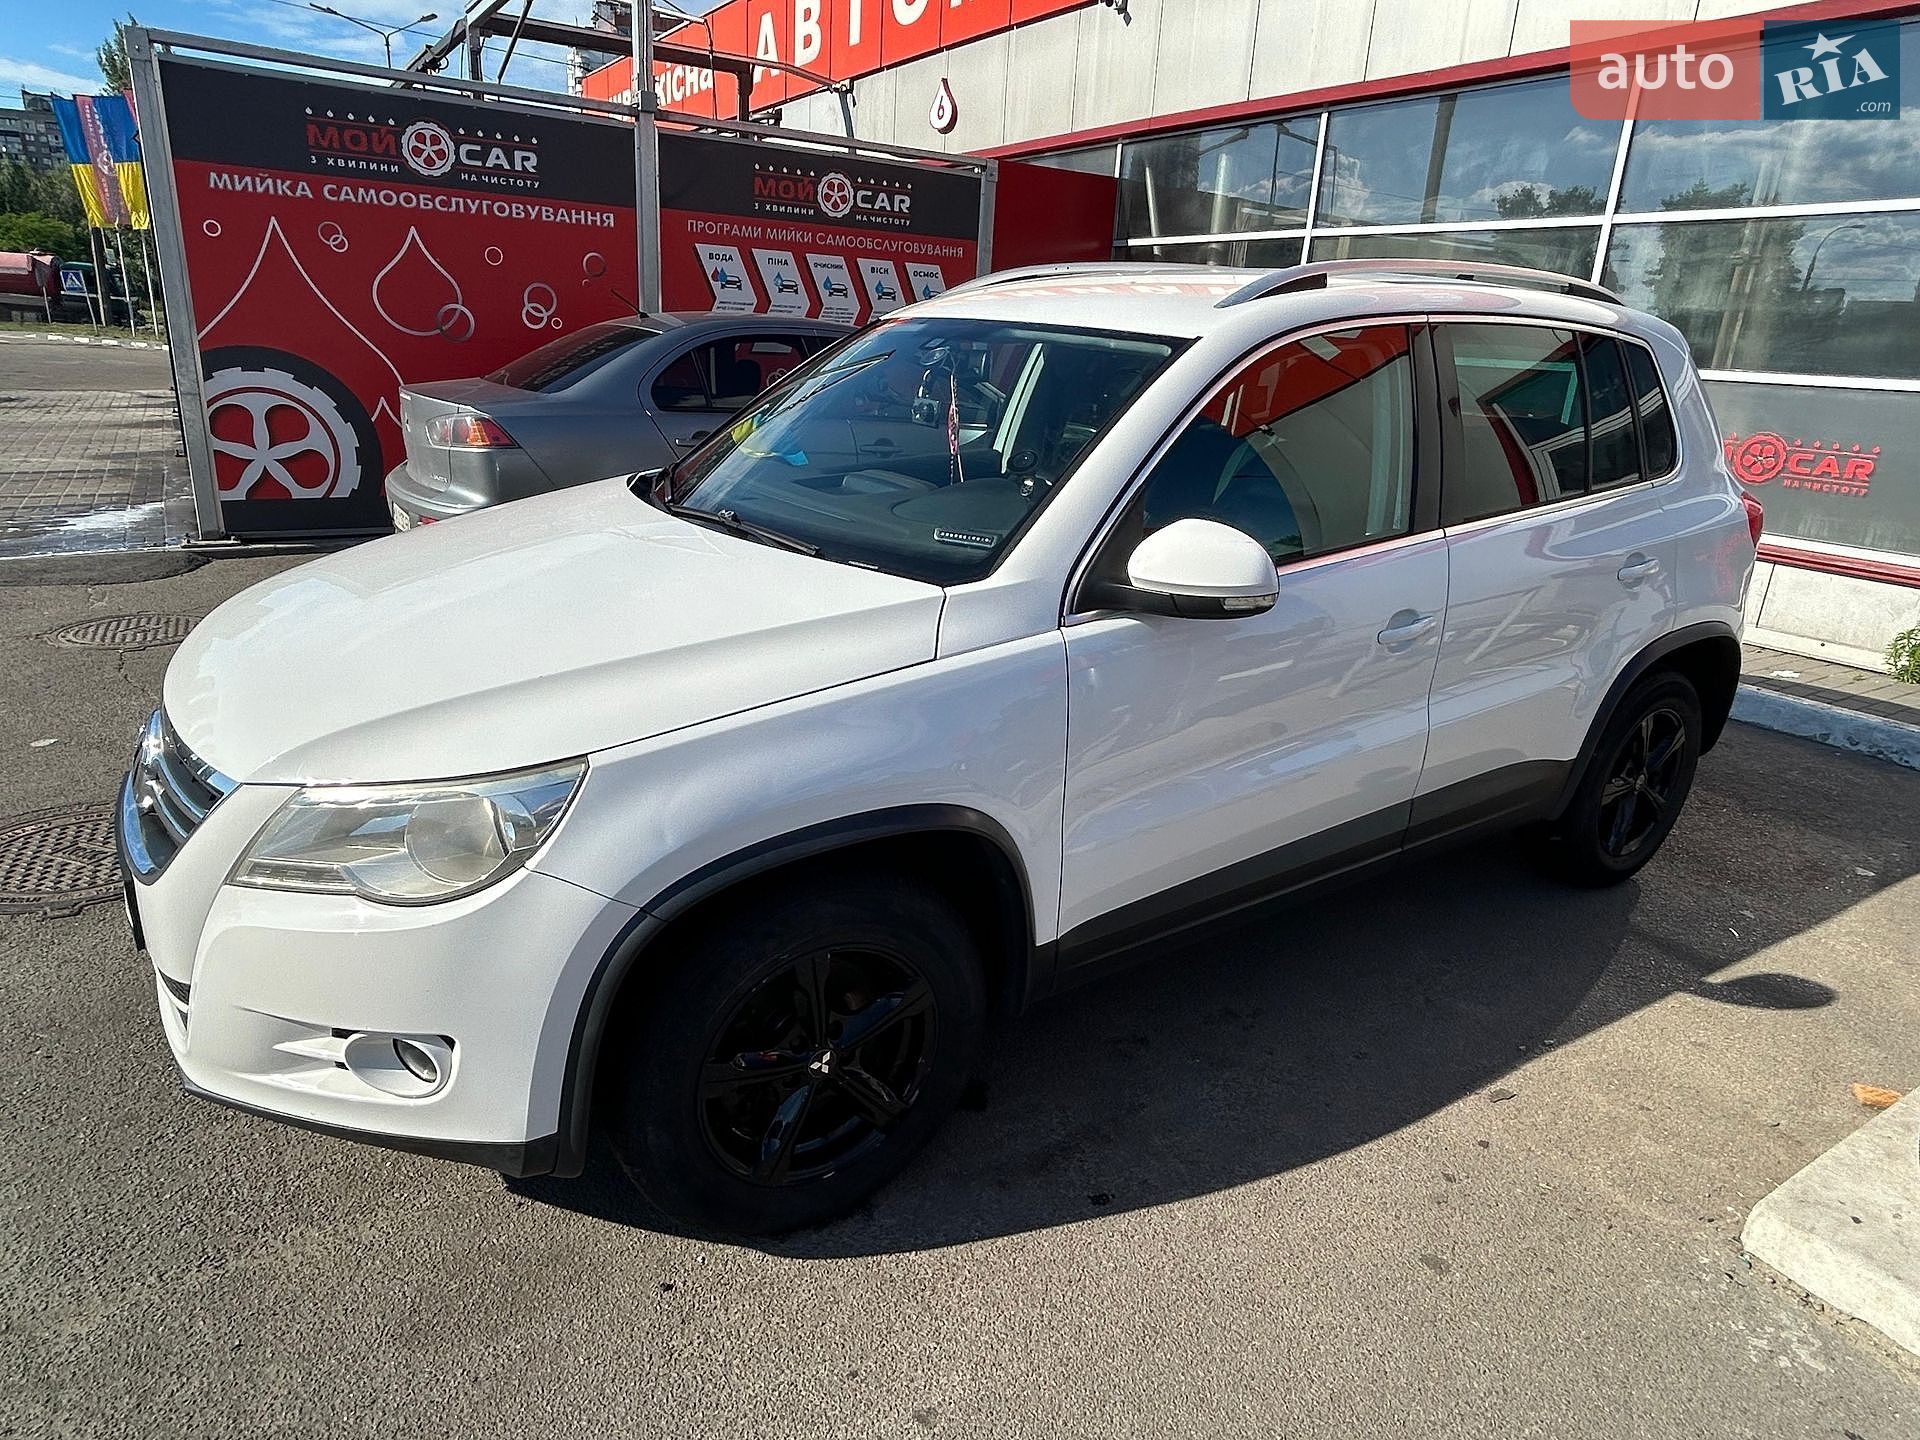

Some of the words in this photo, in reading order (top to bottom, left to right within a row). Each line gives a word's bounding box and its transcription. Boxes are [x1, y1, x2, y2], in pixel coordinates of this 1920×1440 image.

[305, 123, 397, 155] МОЙ
[459, 143, 538, 173] CAR
[326, 156, 400, 173] ХВИЛИНИ
[461, 172, 478, 182] НА
[481, 175, 541, 189] ЧИСТОТУ
[208, 171, 314, 199] МИЙКА
[323, 183, 615, 228] САМООБСЛУГОВУВАННЯ
[753, 176, 815, 202] МОЙ
[856, 189, 911, 214] CAR
[765, 203, 815, 216] ХВИЛИНИ
[855, 214, 868, 222] НА
[871, 216, 911, 227] ЧИСТОТУ
[687, 219, 762, 239] ПРОГРАМИ
[766, 227, 812, 244] МИЙКИ
[815, 232, 964, 259] САМООБСЛУГОВУВАННЯ
[708, 252, 734, 262] ВОДА
[767, 257, 789, 266] ПІНА
[912, 270, 940, 279] ОСМОС
[1787, 453, 1875, 481] CAR
[1783, 478, 1800, 489] НА
[1803, 481, 1869, 497] ЧИСТОТУ
